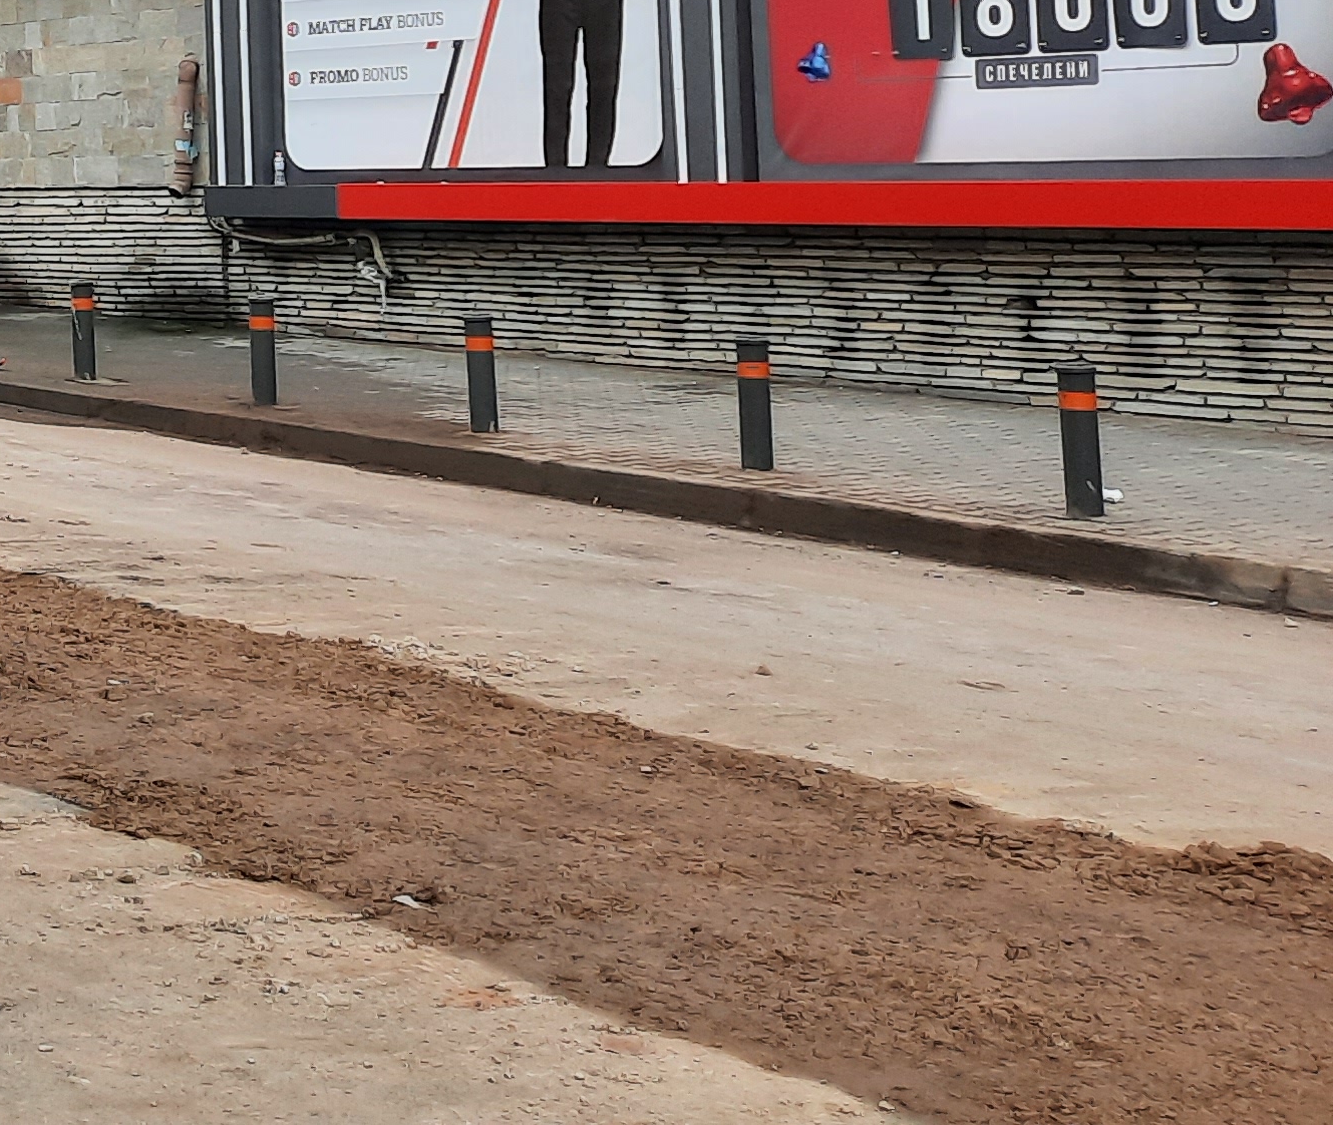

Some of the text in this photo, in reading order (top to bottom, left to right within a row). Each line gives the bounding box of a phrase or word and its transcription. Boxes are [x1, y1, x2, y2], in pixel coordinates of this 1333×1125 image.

[307, 11, 444, 36] MATCH PLAY BONUS
[309, 66, 409, 85] PROMO BONUS
[984, 59, 1090, 83] СПЕЧЕЛЕНИ
